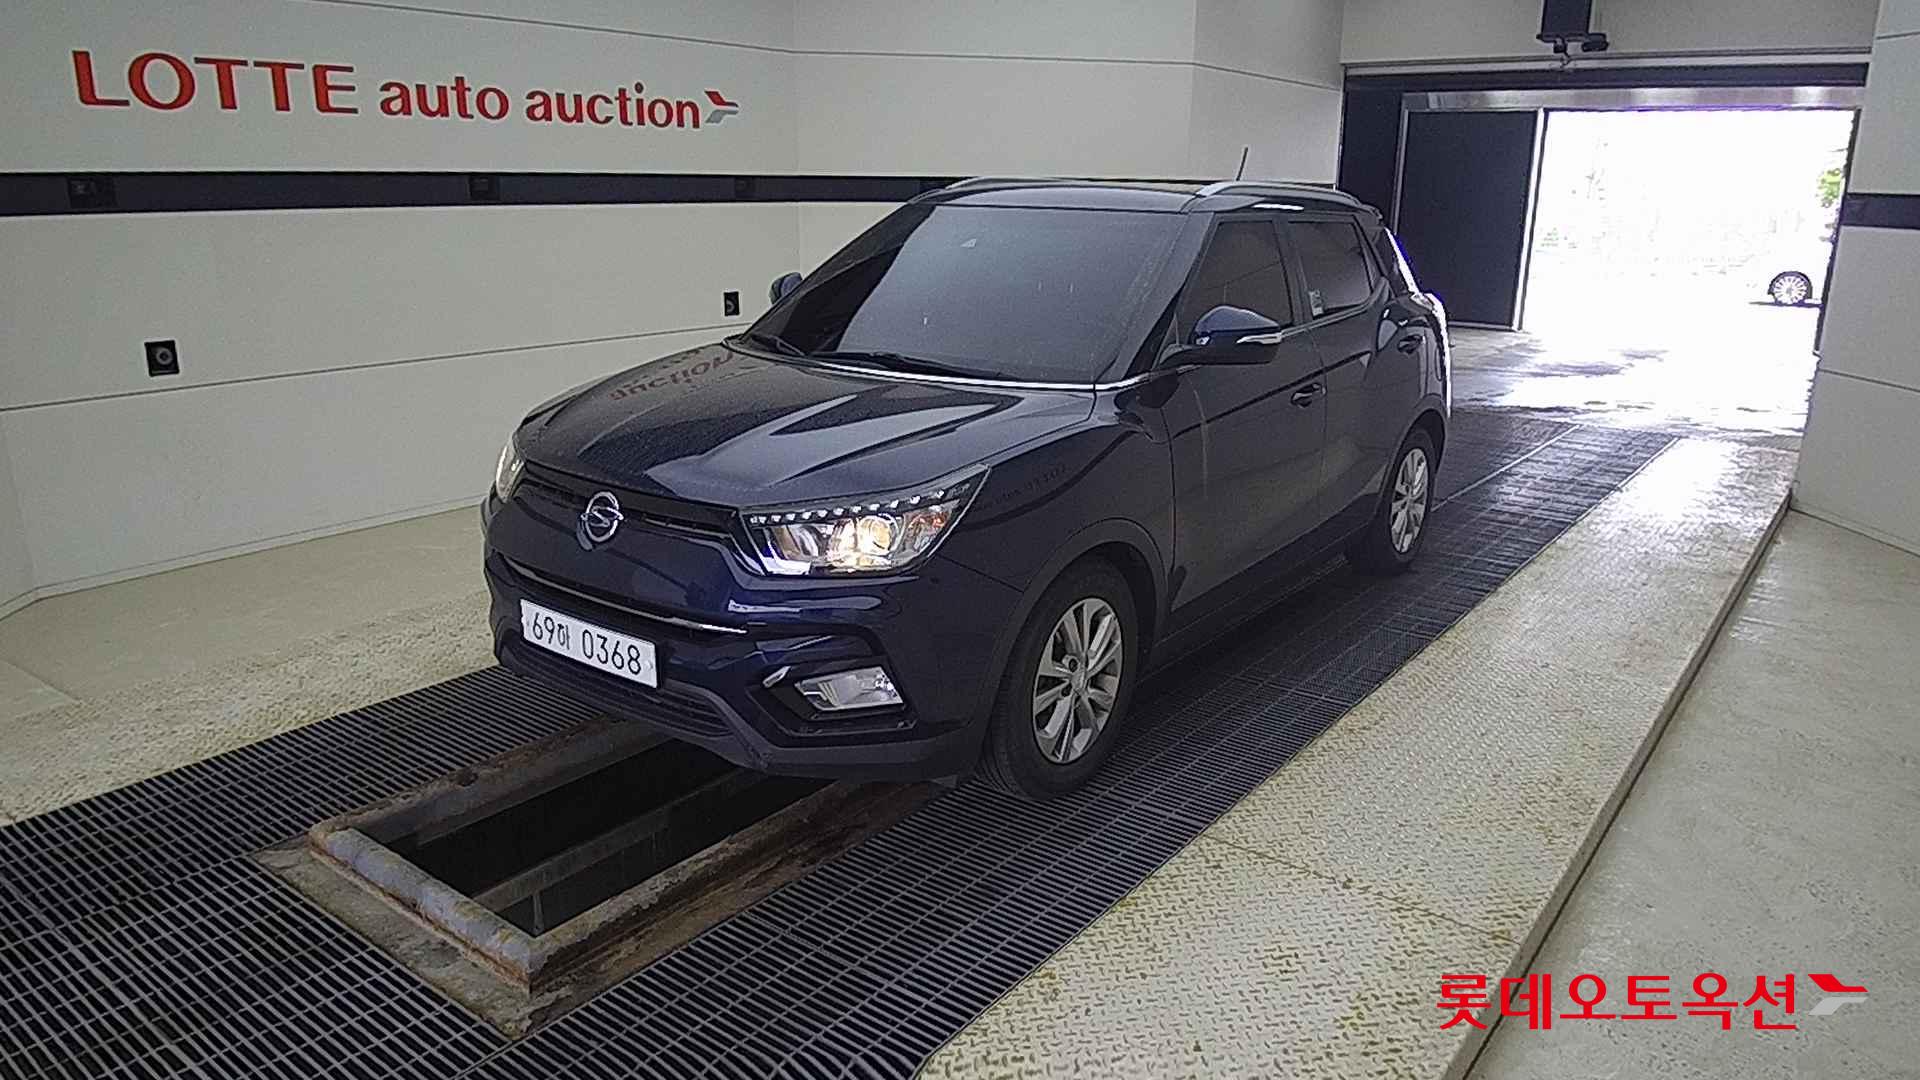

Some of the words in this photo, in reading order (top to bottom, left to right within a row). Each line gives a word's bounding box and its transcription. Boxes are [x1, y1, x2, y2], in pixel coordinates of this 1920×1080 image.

[72, 50, 360, 115] LOTTE
[378, 75, 510, 122] auto
[525, 81, 701, 129] auction
[582, 629, 642, 675] 0368
